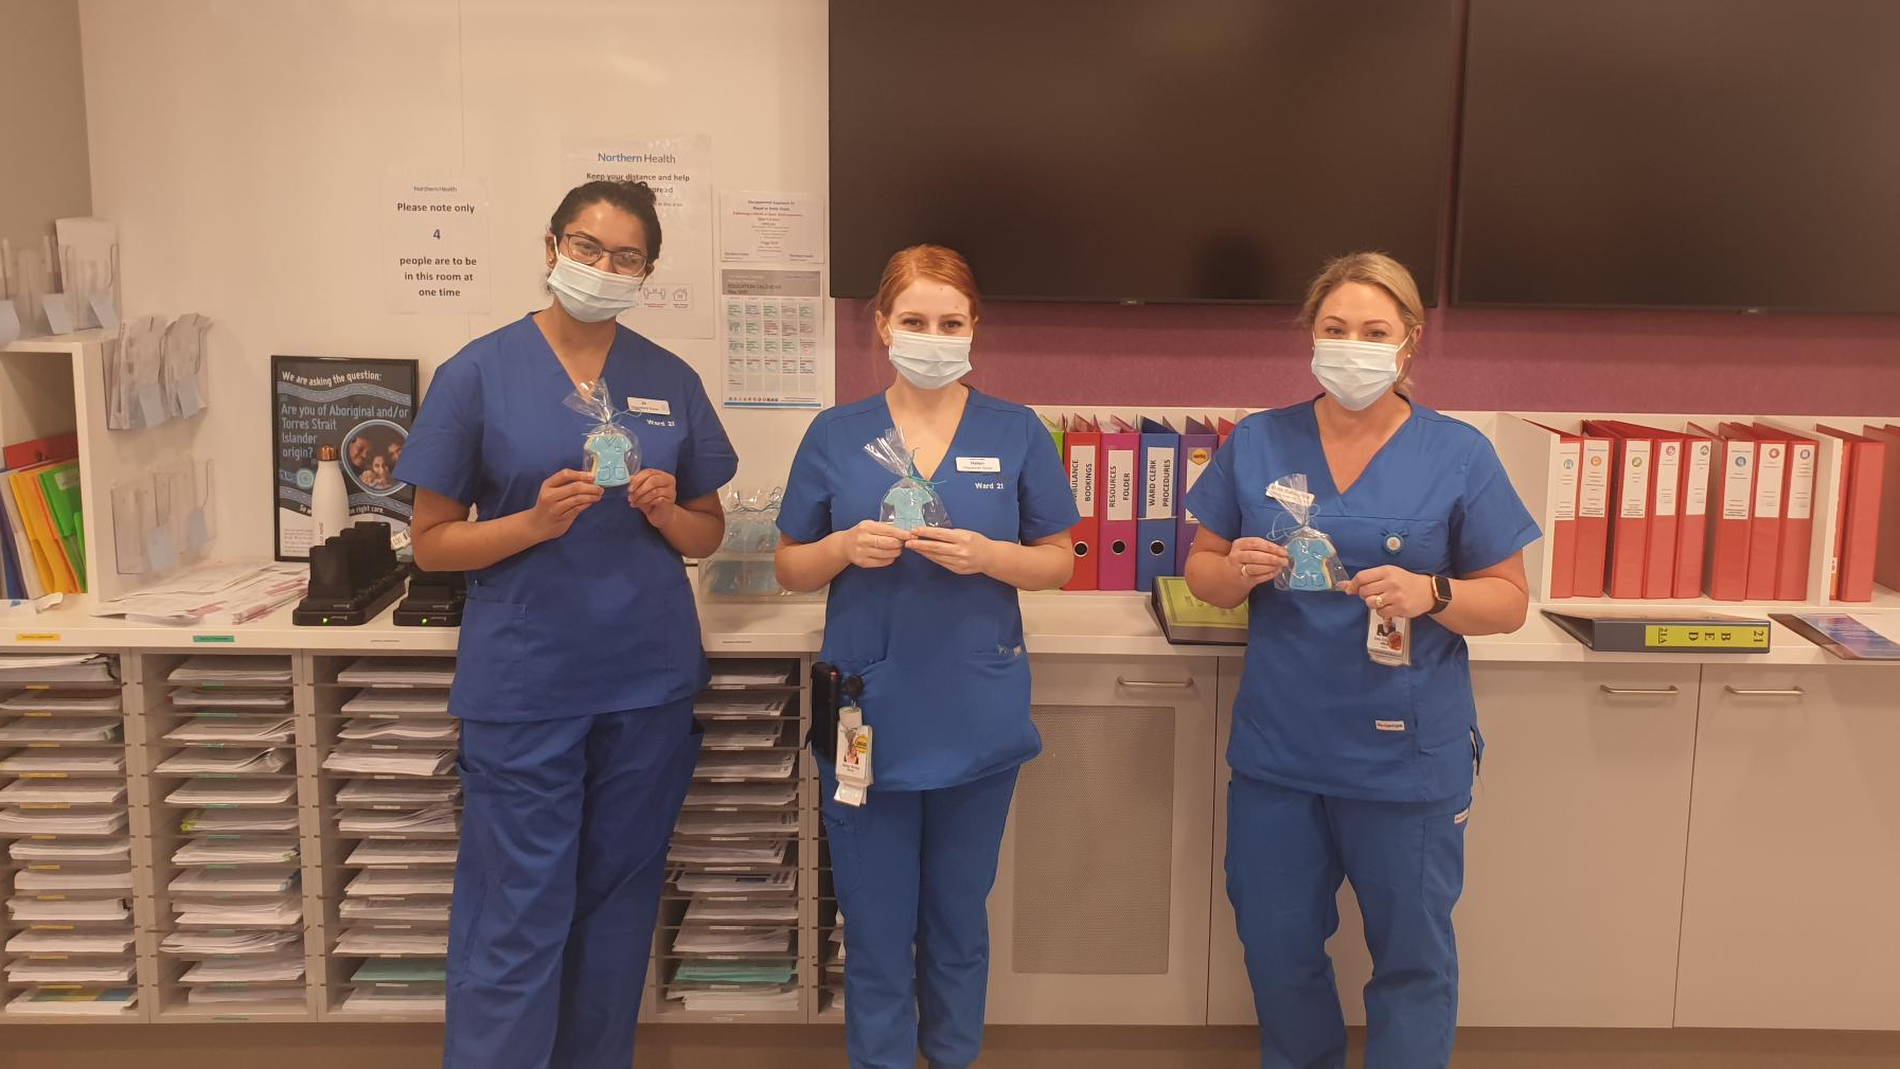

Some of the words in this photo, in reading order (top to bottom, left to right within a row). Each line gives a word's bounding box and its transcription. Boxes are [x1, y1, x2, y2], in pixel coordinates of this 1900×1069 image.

[598, 153, 642, 162] Northern
[644, 154, 676, 164] Health
[586, 172, 605, 180] Keep
[397, 202, 428, 212] Please
[430, 204, 452, 212] note
[454, 203, 475, 214] only
[433, 228, 441, 240] 4
[400, 256, 432, 266] people
[452, 258, 462, 266] to
[466, 257, 477, 266] be
[404, 272, 413, 280] in
[416, 272, 434, 280] this
[439, 288, 461, 296] time
[282, 371, 294, 381] We
[296, 375, 308, 385] are
[309, 377, 332, 387] asking
[332, 374, 345, 384] the
[346, 370, 382, 383] question:
[281, 403, 297, 414] Are
[300, 406, 315, 417] you
[317, 404, 327, 416] of
[329, 405, 375, 419] Aboriginal
[376, 406, 409, 418] and/or
[282, 418, 309, 429] Torres
[311, 418, 337, 430] Strait
[282, 432, 317, 444] Islander
[282, 447, 314, 460] origin?
[356, 505, 370, 514] right
[1659, 627, 1668, 644] 21A
[1753, 630, 1764, 642] 21
